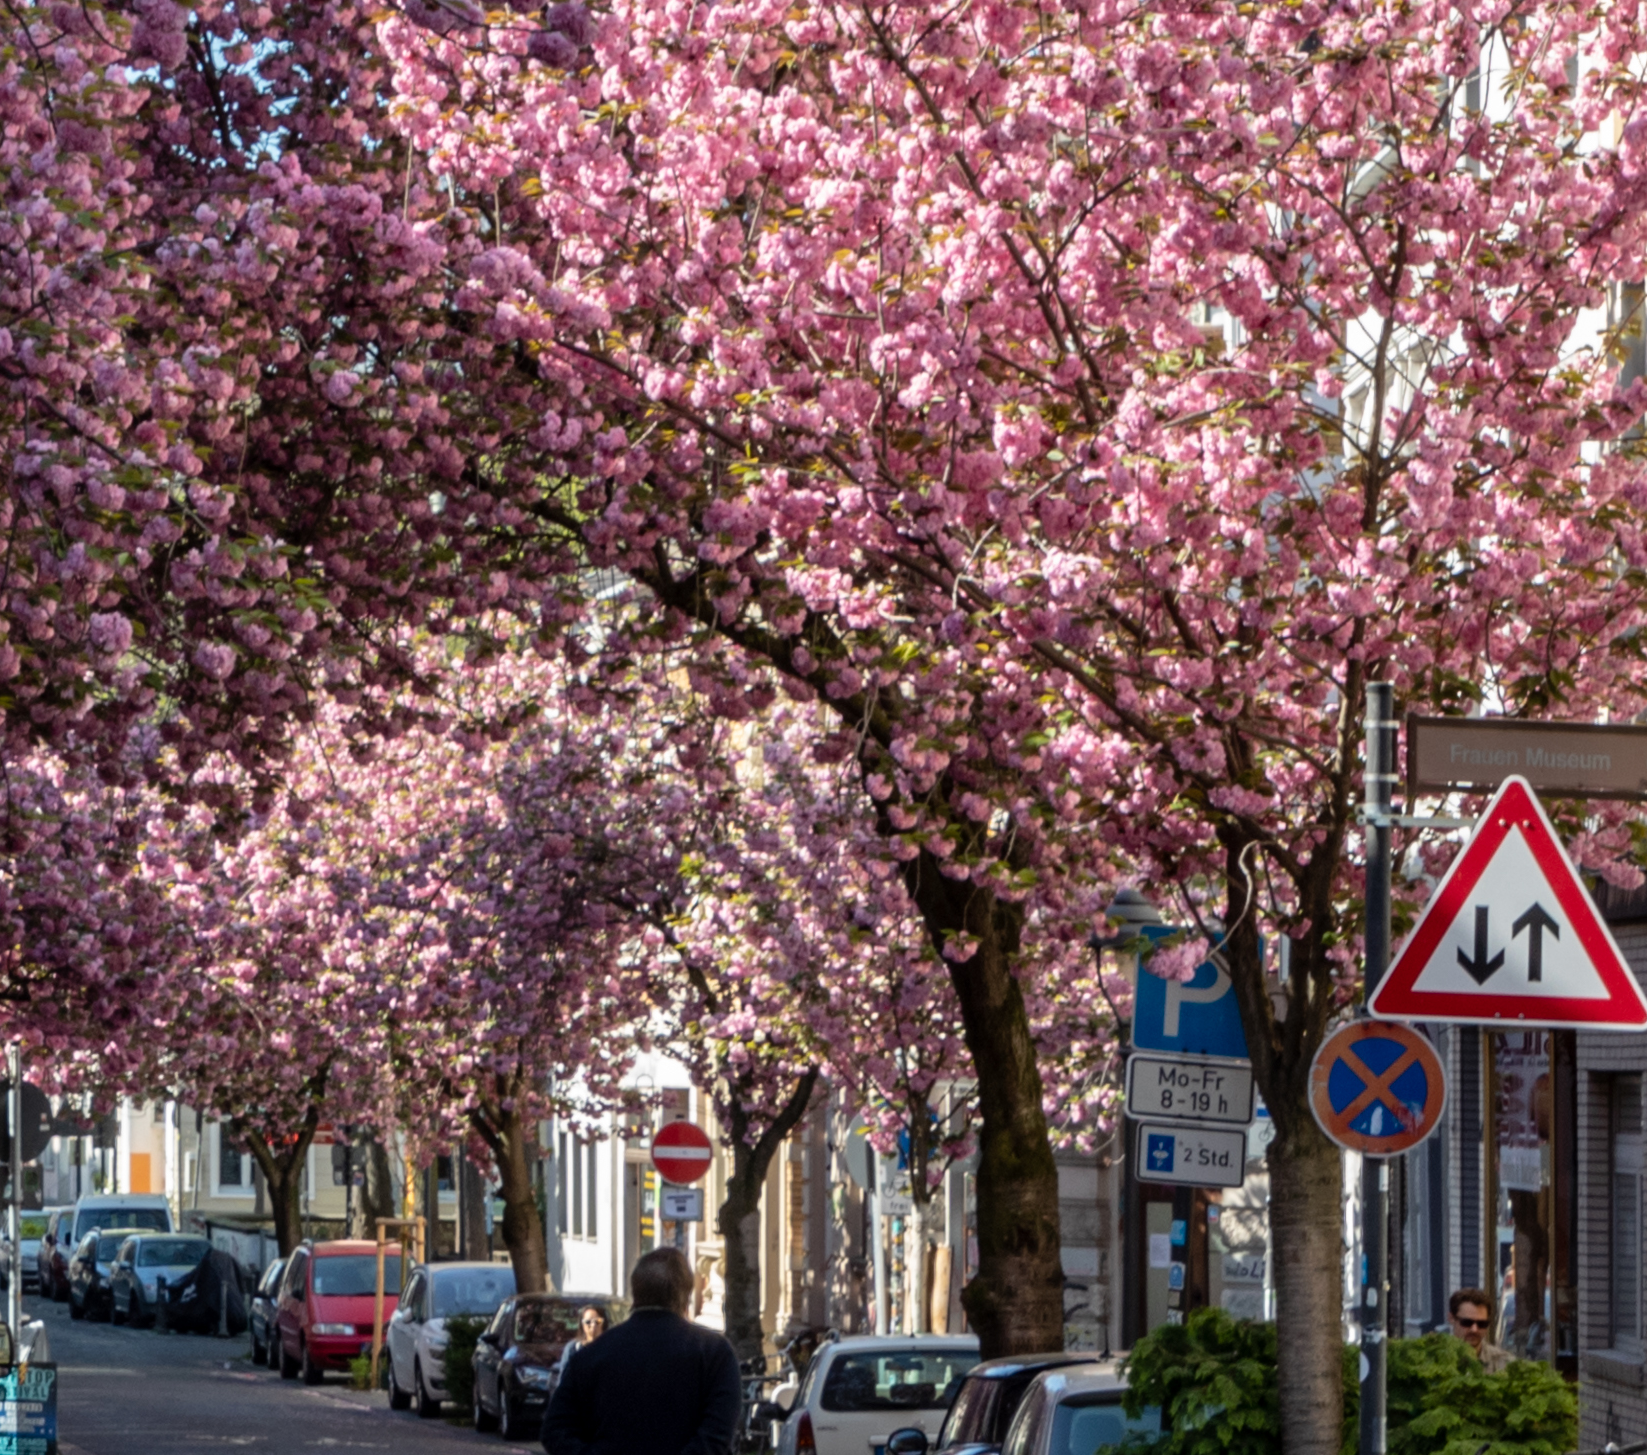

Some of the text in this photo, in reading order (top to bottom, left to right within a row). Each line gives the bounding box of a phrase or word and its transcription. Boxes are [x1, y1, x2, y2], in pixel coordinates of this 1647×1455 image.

[1450, 744, 1612, 770] Frauen Museum
[1158, 1066, 1225, 1091] Mo-Fr
[1183, 1149, 1234, 1168] 2 Std.
[889, 1200, 909, 1211] frei
